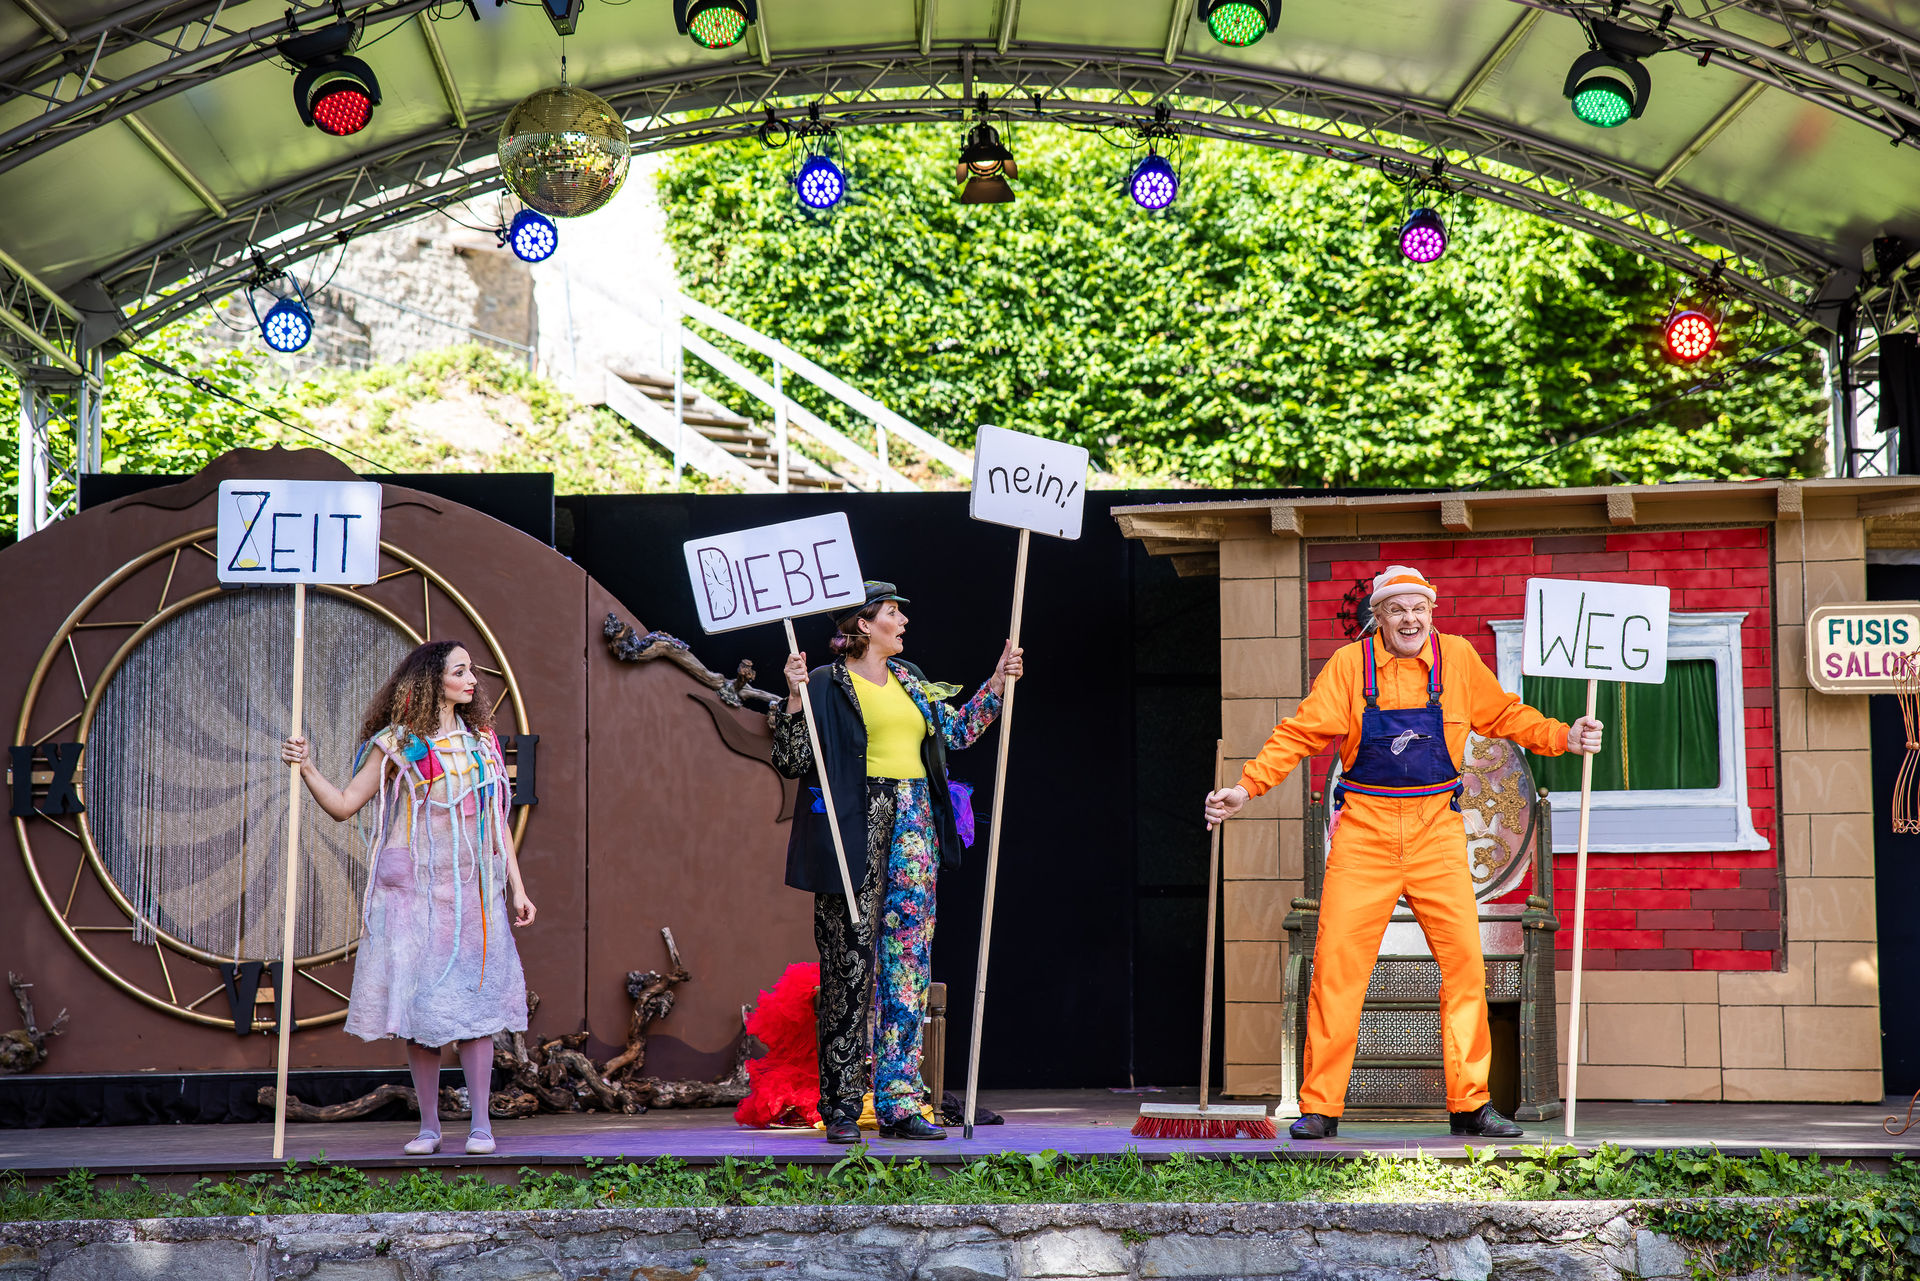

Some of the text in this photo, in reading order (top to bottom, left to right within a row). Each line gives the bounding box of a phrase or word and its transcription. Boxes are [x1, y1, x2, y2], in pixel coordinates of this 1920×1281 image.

[987, 463, 1079, 508] nein!
[227, 490, 362, 573] ZEIT
[697, 538, 850, 622] DIEBE
[1539, 588, 1651, 671] WEG
[1828, 618, 1909, 646] FUSIS
[8, 742, 86, 817] IX
[219, 961, 299, 1036] VI
